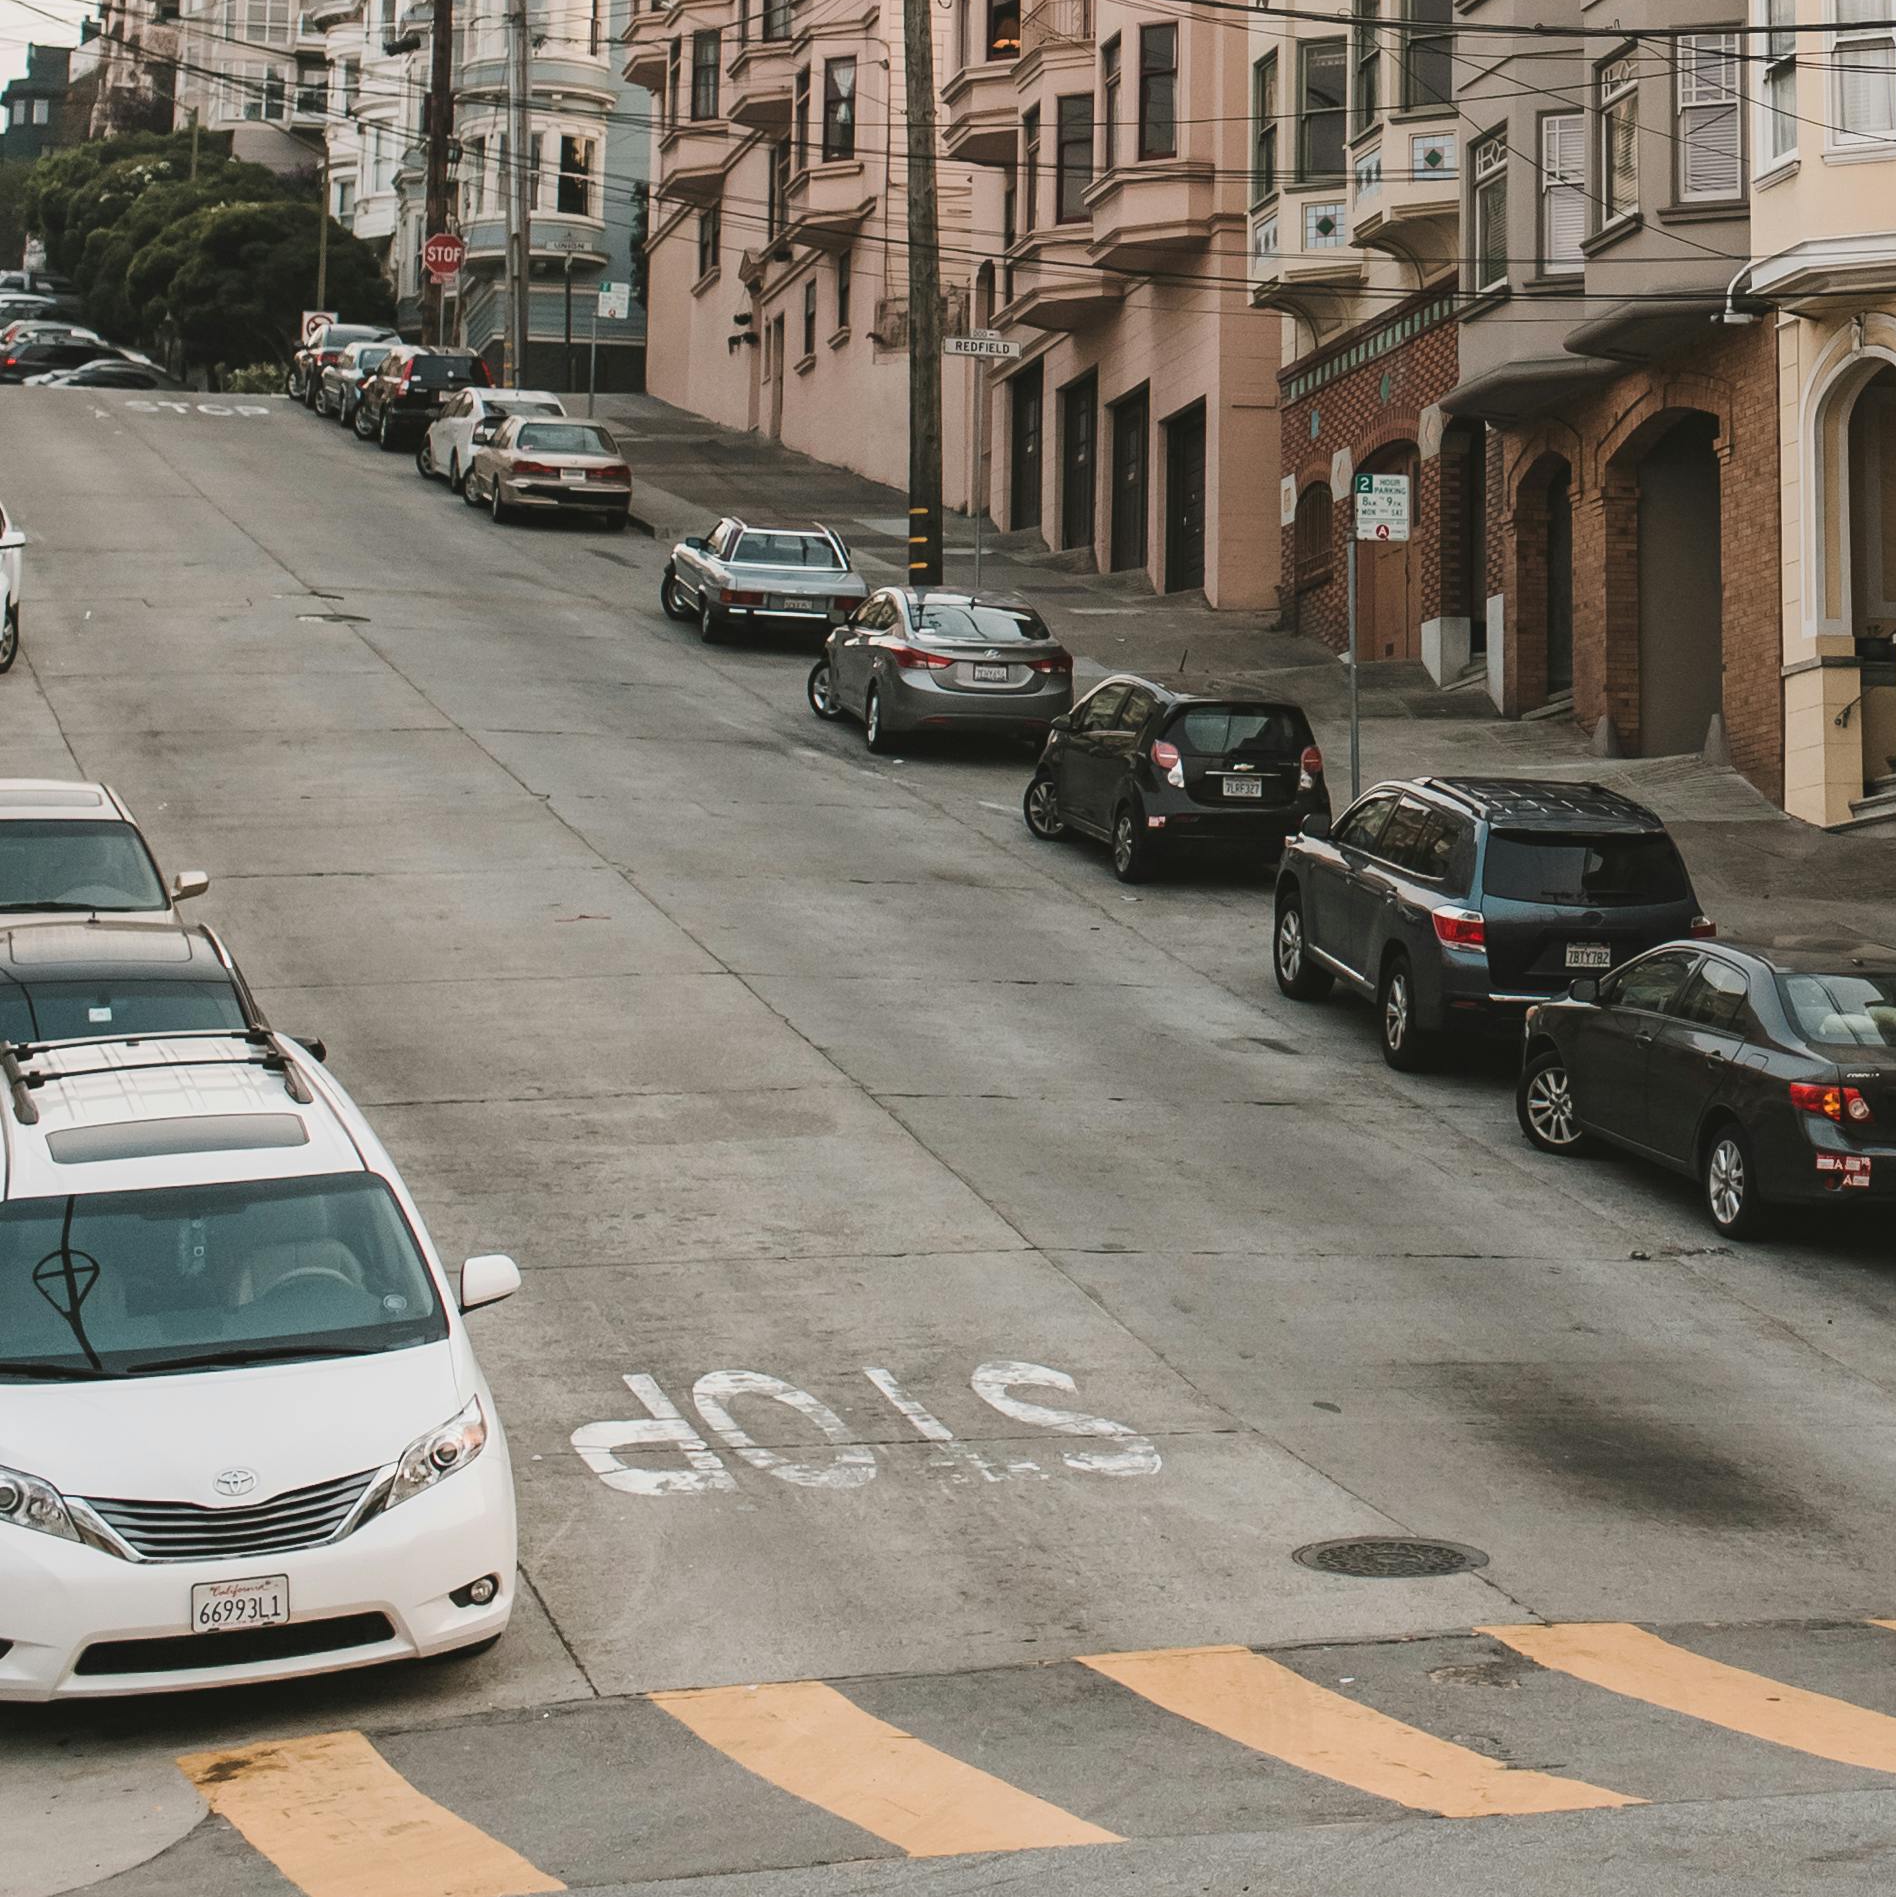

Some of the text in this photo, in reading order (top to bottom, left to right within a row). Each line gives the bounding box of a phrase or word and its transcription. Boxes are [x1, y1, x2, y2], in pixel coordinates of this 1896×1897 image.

[426, 245, 462, 262] STOP
[955, 340, 1010, 354] REDFIELD
[125, 401, 270, 416] STOP
[1360, 476, 1370, 491] 2
[1374, 486, 1407, 495] PARKING
[1378, 525, 1388, 536] A
[570, 1360, 1163, 1496] STOP
[199, 1595, 281, 1624] 66993L1
